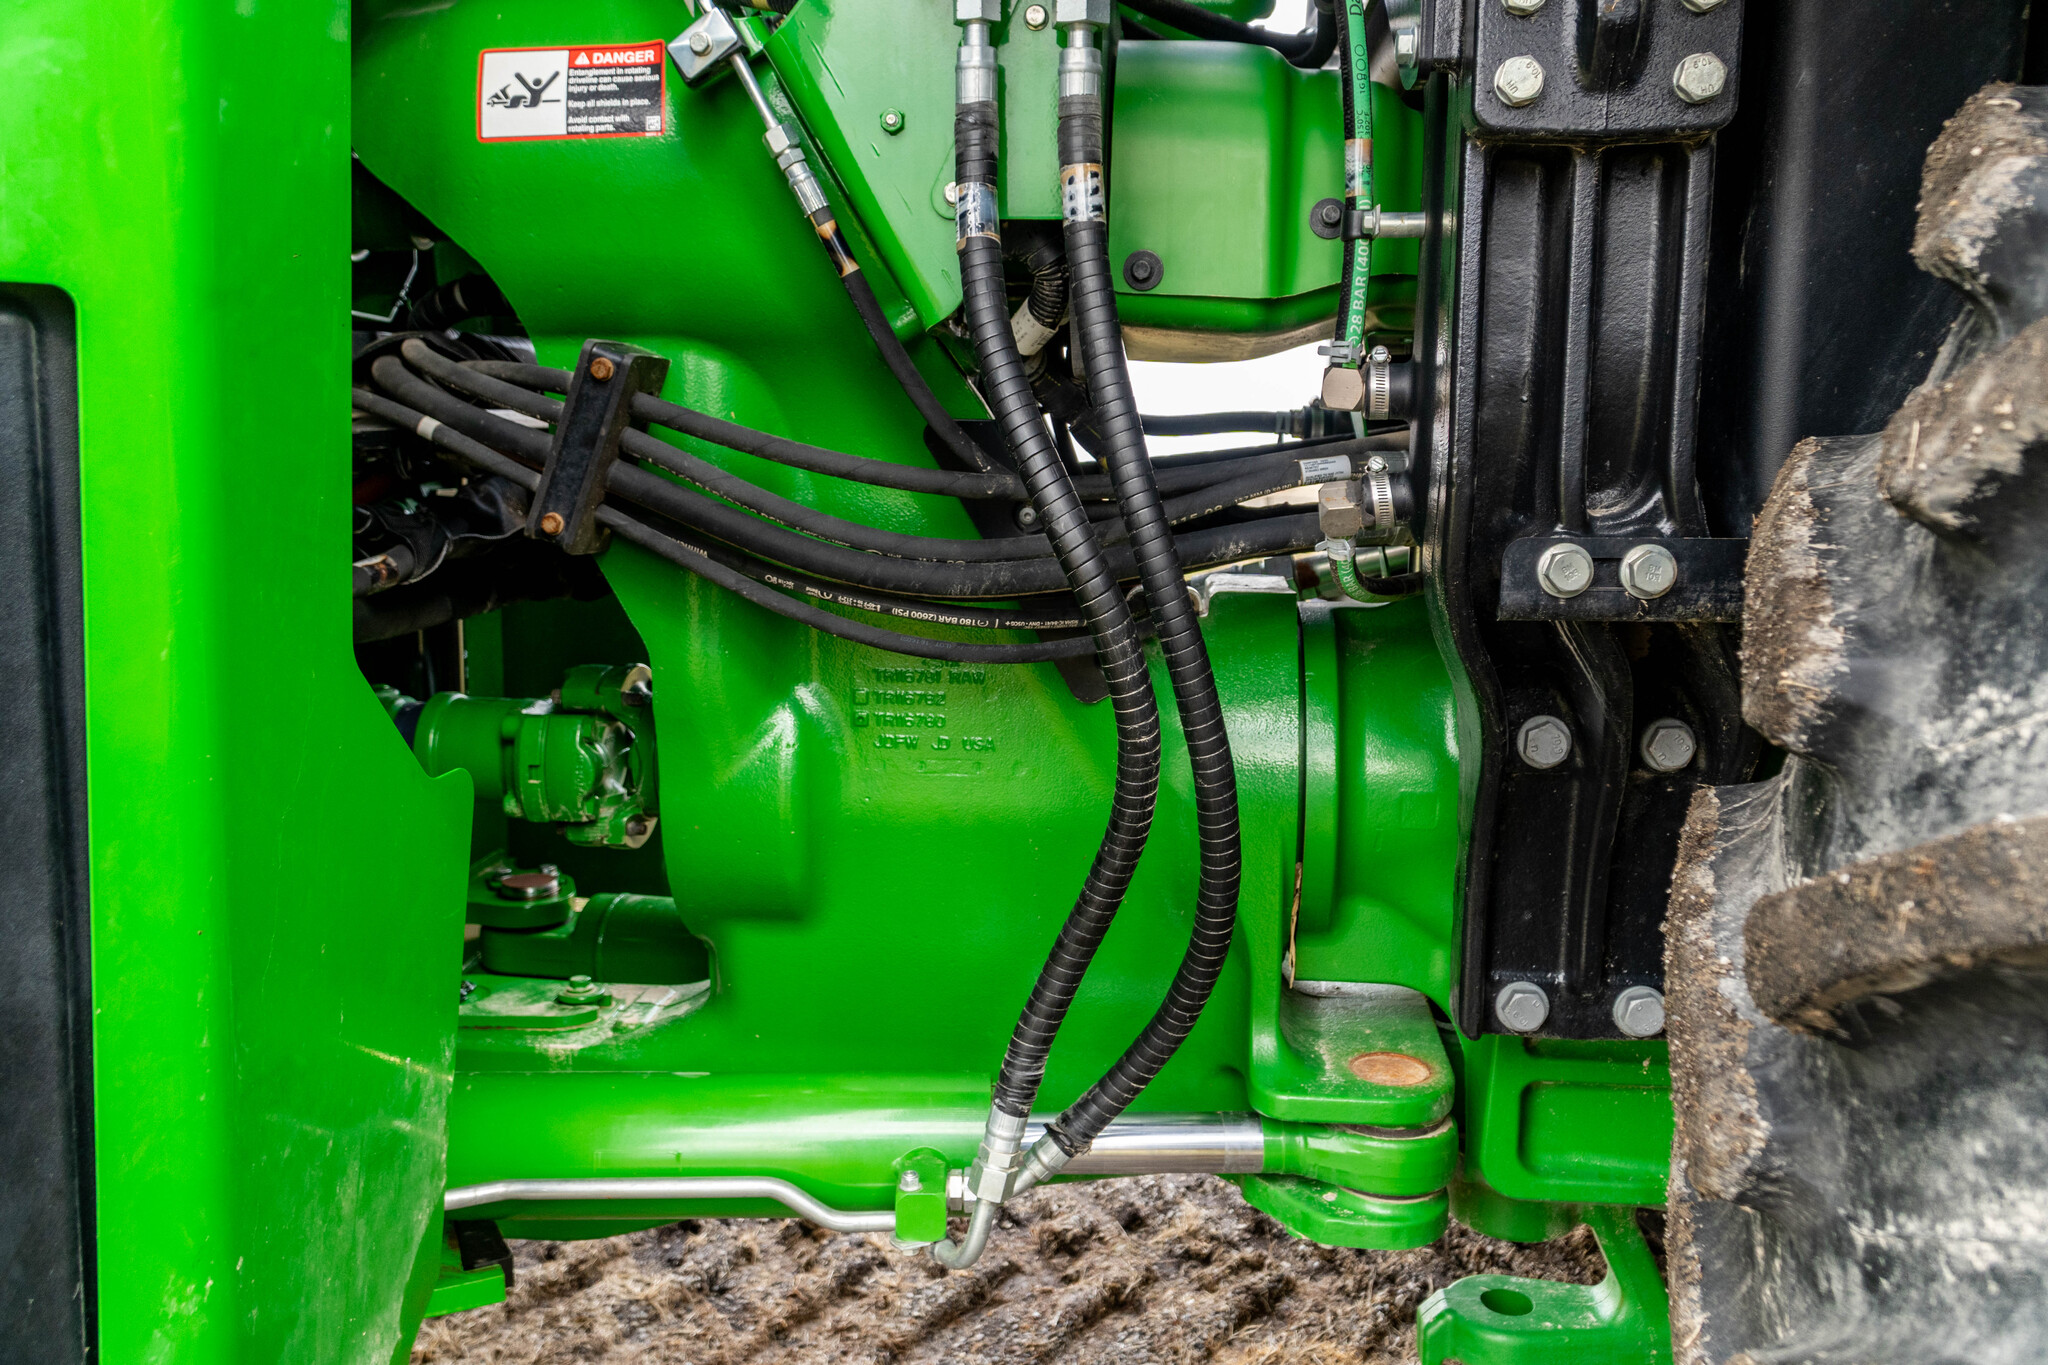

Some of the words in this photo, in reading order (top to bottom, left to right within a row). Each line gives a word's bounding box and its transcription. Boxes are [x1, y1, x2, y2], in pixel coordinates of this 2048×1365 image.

[592, 50, 655, 64] DANGER
[568, 68, 615, 77] Entanglement
[616, 67, 624, 75] in
[624, 66, 651, 75] rotating
[612, 75, 634, 83] cause
[634, 74, 660, 82] serious
[567, 85, 588, 93] injury
[597, 83, 620, 91] death.
[567, 100, 586, 109] Keep
[586, 99, 596, 107] all
[596, 98, 621, 107] shields
[622, 98, 629, 106] in
[629, 97, 651, 107] place.
[567, 115, 587, 124] Avoid
[588, 115, 614, 123] contact
[614, 113, 630, 122] with
[567, 124, 595, 134] rotating
[595, 123, 616, 133] parts.
[1352, 276, 1367, 311] BAR
[1350, 315, 1363, 334] 28
[892, 607, 909, 617] PSI)
[911, 610, 937, 622] (2600
[938, 614, 958, 625] BAR
[960, 618, 977, 627] 180
[949, 668, 987, 685] RAW
[931, 735, 951, 751] JD
[961, 736, 996, 752] USA
